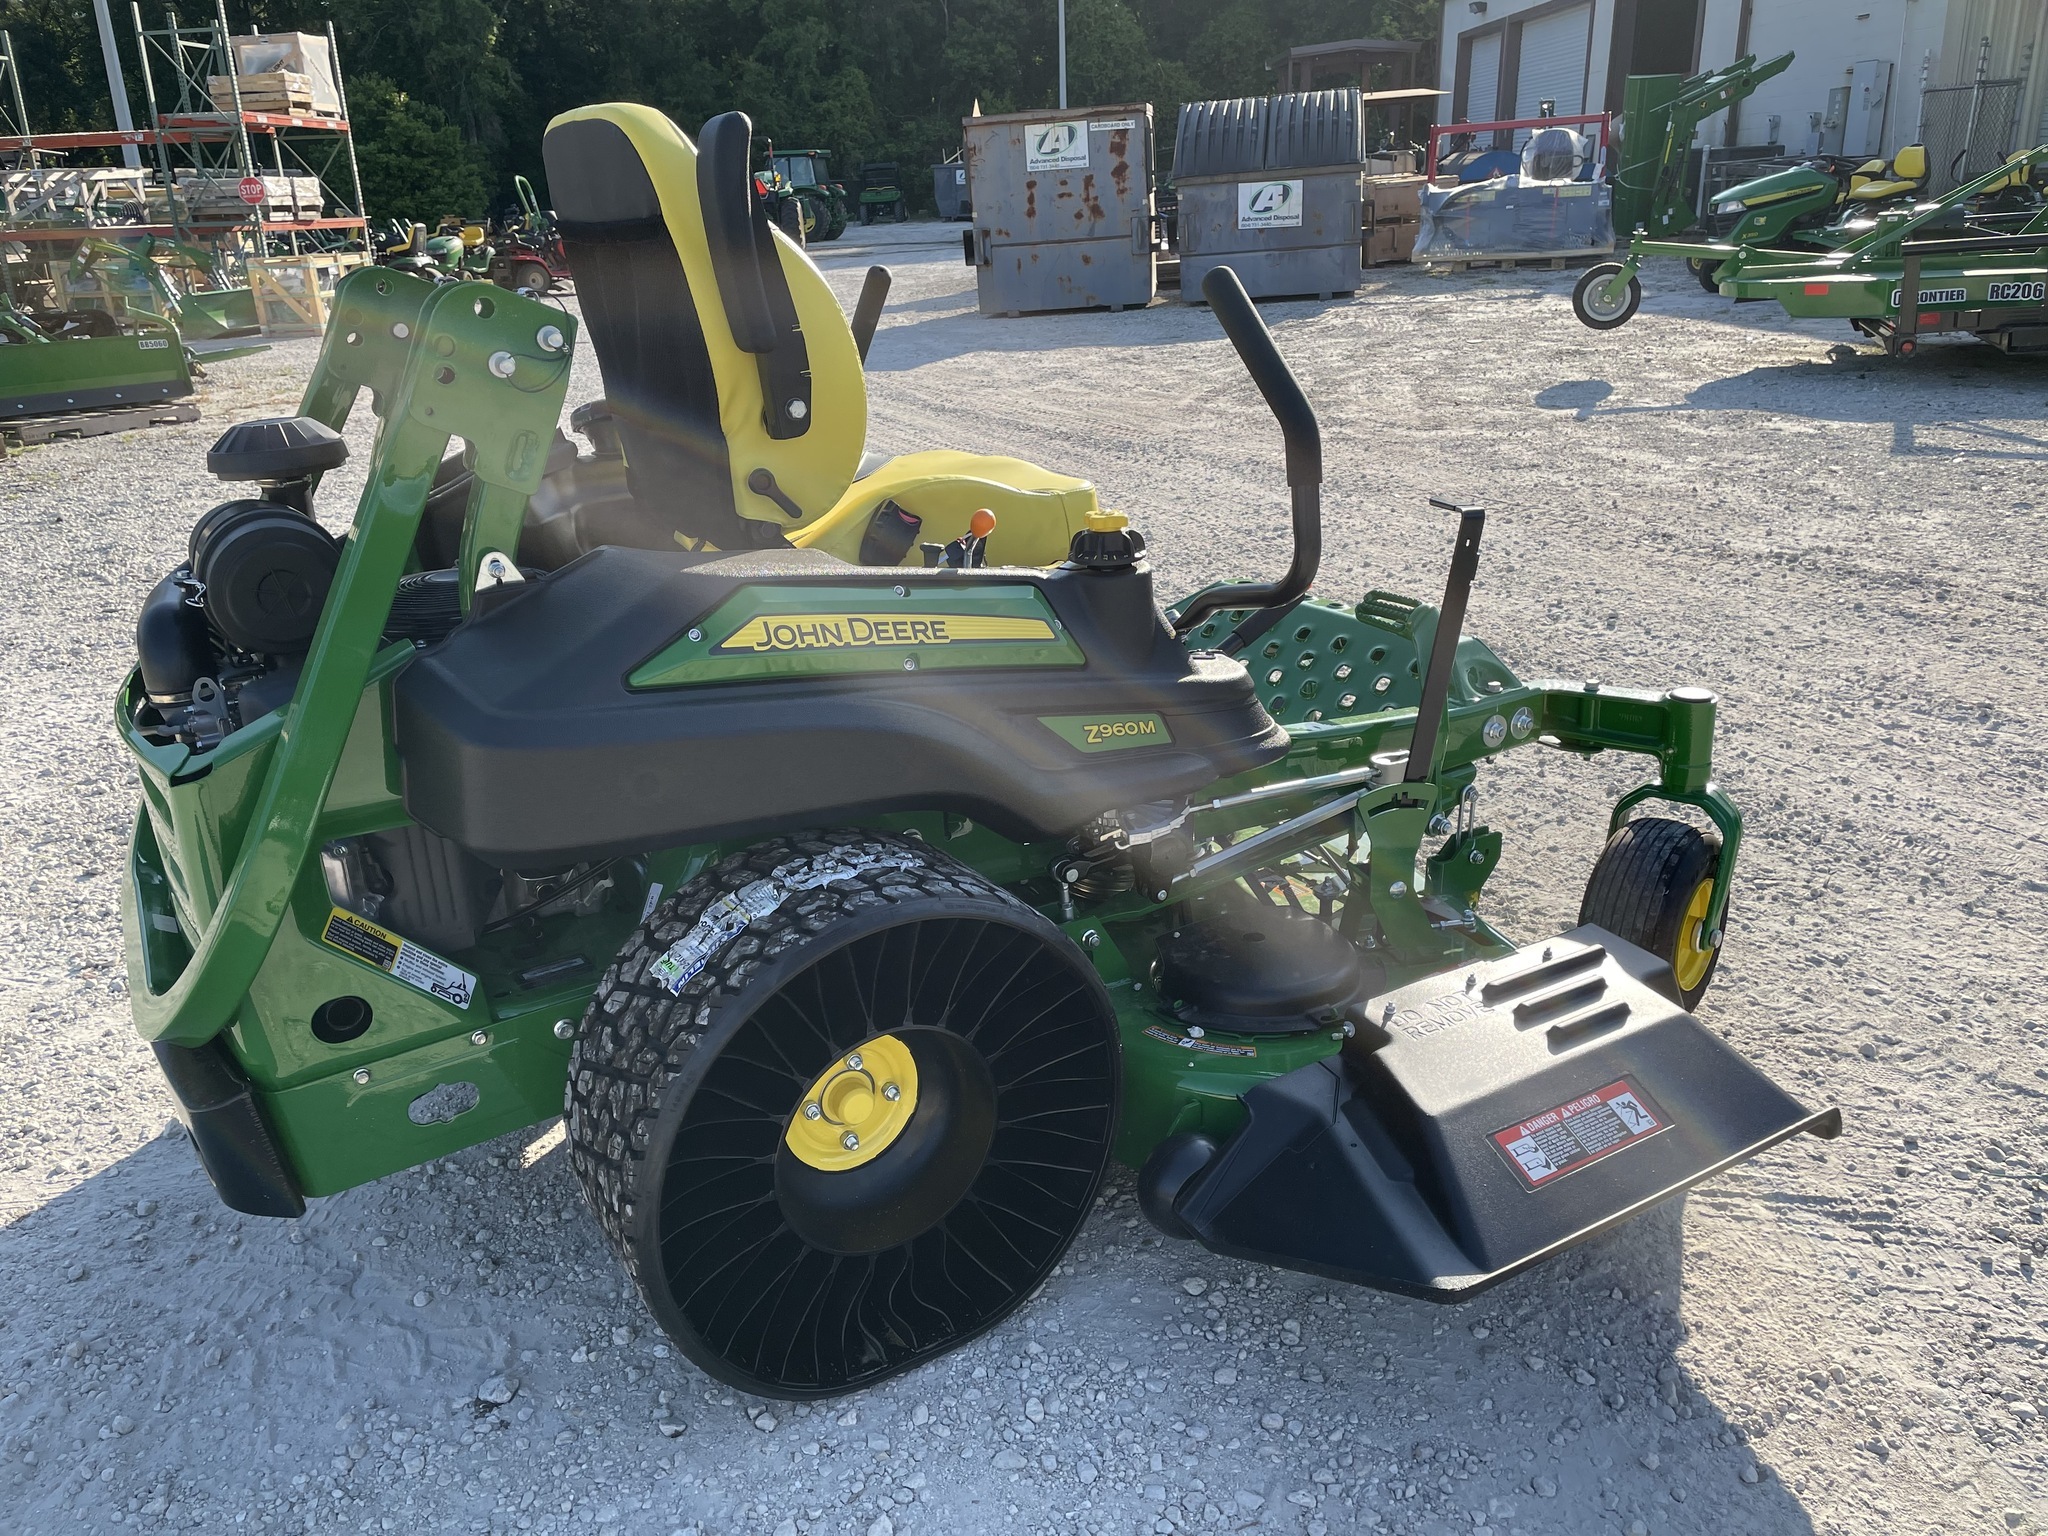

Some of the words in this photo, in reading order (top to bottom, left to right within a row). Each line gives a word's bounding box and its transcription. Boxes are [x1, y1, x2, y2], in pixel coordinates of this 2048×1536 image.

[1030, 156, 1060, 164] Advanced
[240, 184, 262, 194] STOP
[1274, 214, 1300, 222] Disposal
[1917, 290, 1965, 303] ONTIER
[756, 620, 842, 648] JOHN
[847, 617, 951, 644] DEERE
[1082, 718, 1158, 744] Z960M
[354, 919, 387, 940] CAUTION
[1390, 1009, 1422, 1027] DO
[1426, 990, 1473, 1012] NOT
[1402, 1000, 1495, 1040] REMOVE
[1526, 1112, 1560, 1132] DANGER
[1568, 1094, 1602, 1114] PELIGRO
